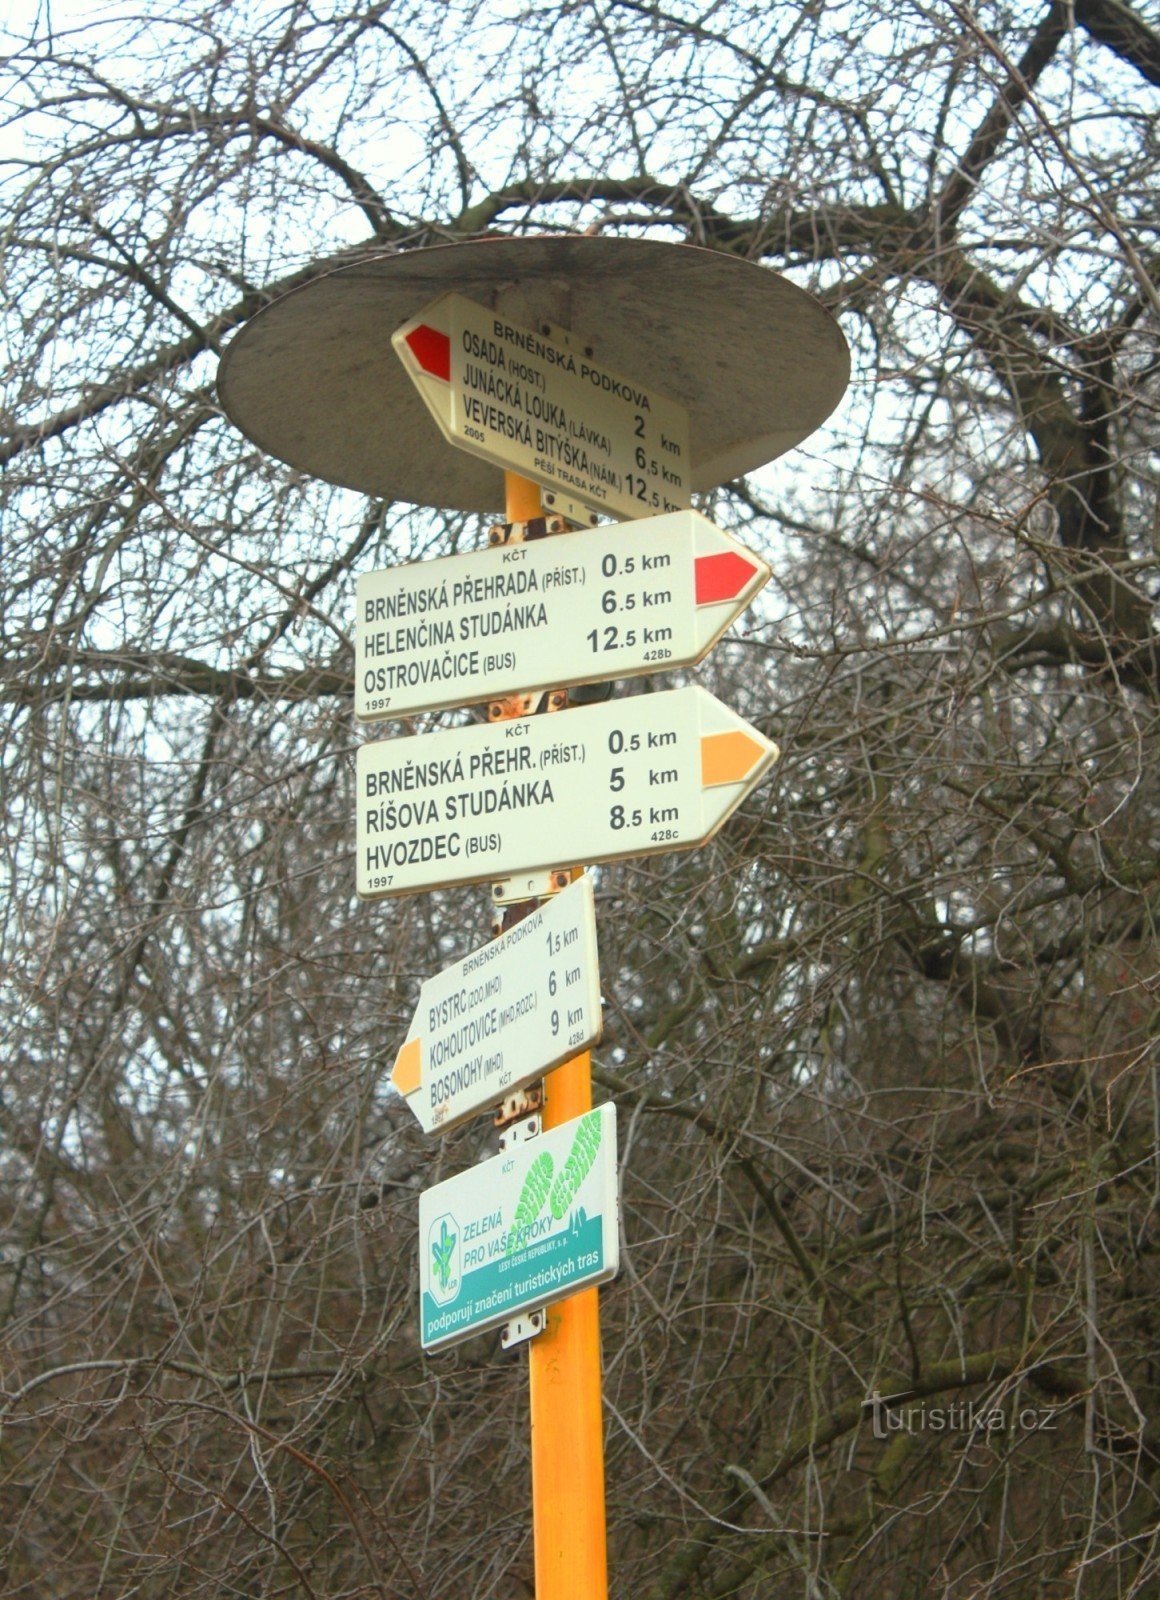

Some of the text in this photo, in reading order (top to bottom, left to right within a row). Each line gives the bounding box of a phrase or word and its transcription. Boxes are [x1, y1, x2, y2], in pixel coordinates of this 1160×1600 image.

[463, 329, 681, 456] OSADA (HOST.) 2 km
[493, 320, 651, 412] BRNĚNSKÁ PODKOVA
[463, 363, 522, 412] JUNÁCKÁ
[525, 392, 567, 432] LOUKA
[569, 420, 611, 457] (LÁVKA)
[662, 464, 682, 488] km
[463, 394, 532, 448] VEVERSKÁ
[536, 428, 589, 475] BITÝŠKA
[589, 462, 622, 494] (NÁM.)
[464, 424, 485, 443] 2005
[534, 457, 607, 500] PĚŠÍ TRASA KČT
[502, 549, 527, 563] KČT
[365, 553, 671, 624] BRNĚNSKÁ PŘEHRADA (PŘÍST.) 0.5 km
[365, 590, 672, 658] HELENČINA STUDÁNKA 6.5 km
[643, 648, 672, 662] 428b
[364, 625, 672, 694] OSTROVAČICE (BUS) 12.5 km
[365, 697, 391, 711] 1997
[505, 723, 530, 738] KČT
[366, 730, 677, 797] BRNĚNSKÁ PŘEHR. (PŘÍST.) 0.5 km
[366, 768, 678, 834] RÍŠOVA STUDÁNKA 5 km
[366, 805, 679, 871] HVOZDEC (BUS) 8.5 km
[651, 830, 679, 843] 428c
[367, 875, 394, 889] 1997
[462, 913, 543, 976] BRNĚNSKÁ PODKOVA
[429, 988, 467, 1033] BYSTRC
[546, 931, 561, 957] 1.5
[563, 927, 579, 948] km
[430, 1008, 497, 1070] KOHOUTOVICE
[548, 970, 557, 997] 6
[565, 967, 581, 987] km
[568, 1030, 584, 1046] 428d
[431, 1007, 583, 1108] BOSONOHY (MHD) 9 km
[499, 1071, 512, 1088] KČT
[502, 1160, 515, 1175] KČT
[463, 1206, 502, 1242] ZELENÁ
[464, 1214, 554, 1268] PRO VAŠE KROKY
[427, 1250, 599, 1337] podporují značení turistických tras
[499, 1259, 511, 1273] LESY
